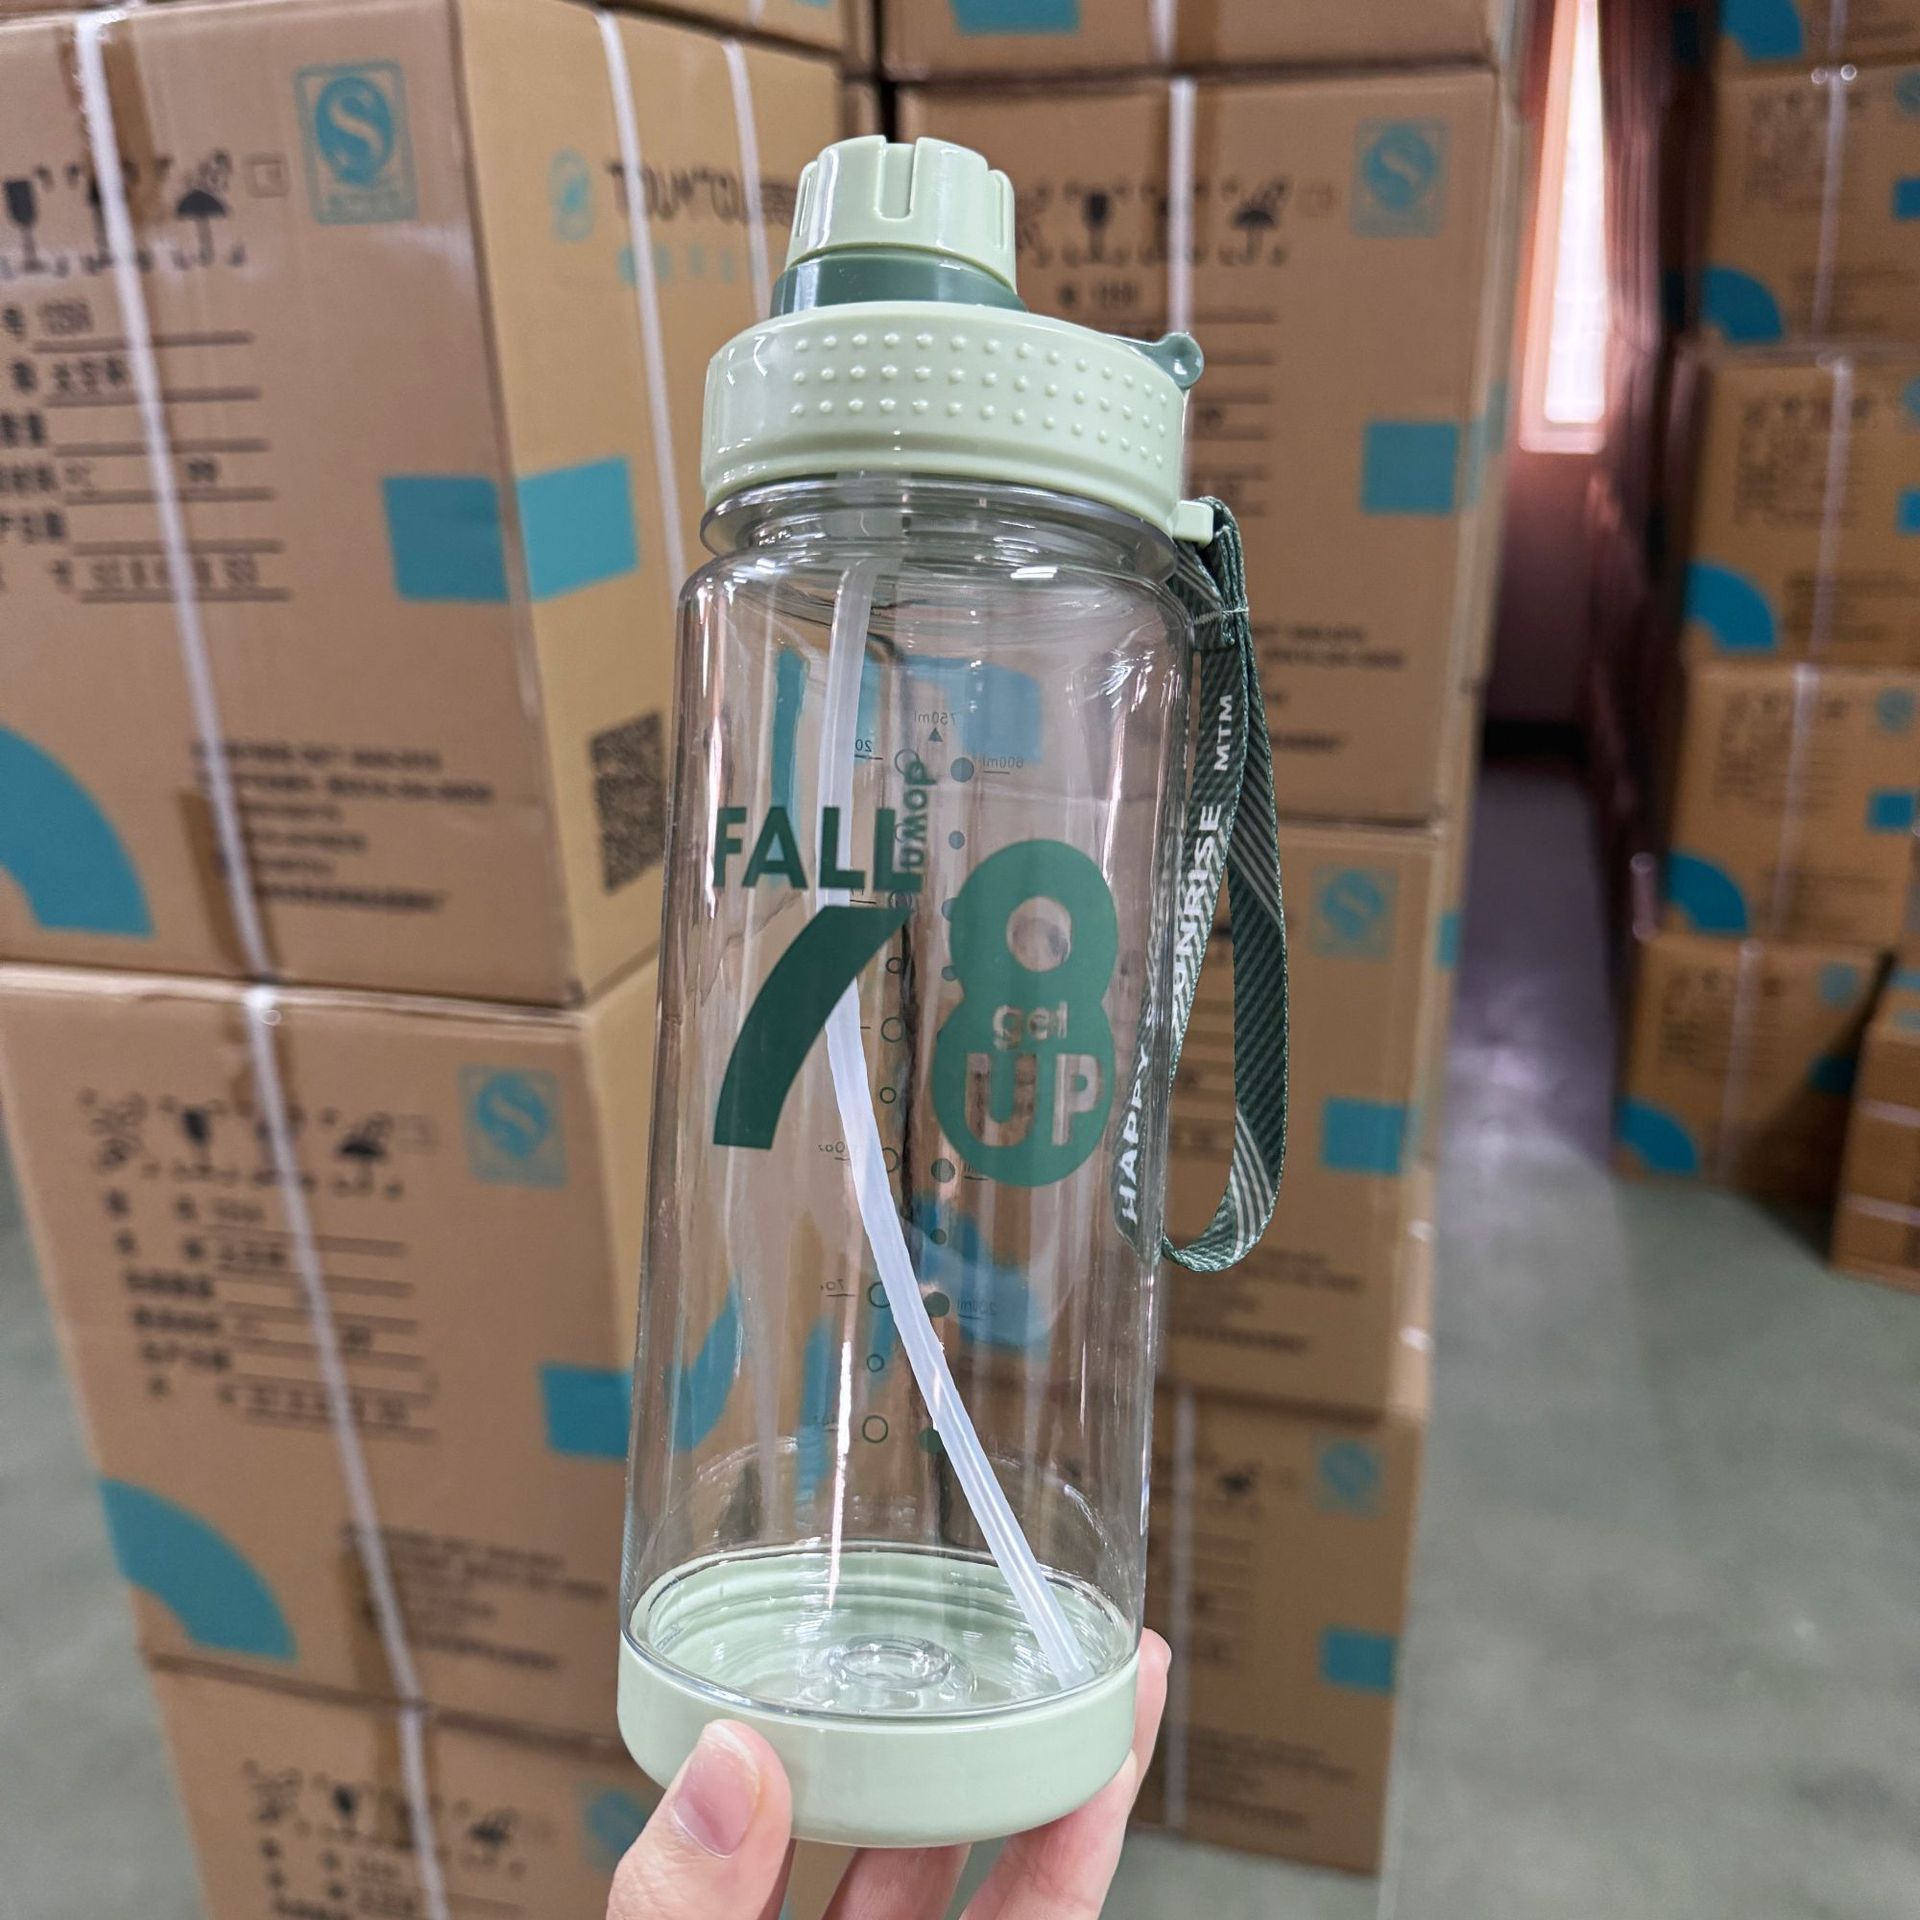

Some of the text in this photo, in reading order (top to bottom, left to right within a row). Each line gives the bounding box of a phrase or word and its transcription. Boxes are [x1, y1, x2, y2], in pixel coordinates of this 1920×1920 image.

[1213, 694, 1233, 772] MTM
[712, 805, 924, 893] FALL
[713, 904, 912, 1150] 7
[930, 837, 1119, 1187] 8
[964, 1052, 1102, 1147] UP
[1119, 1043, 1149, 1225] HAPPY
